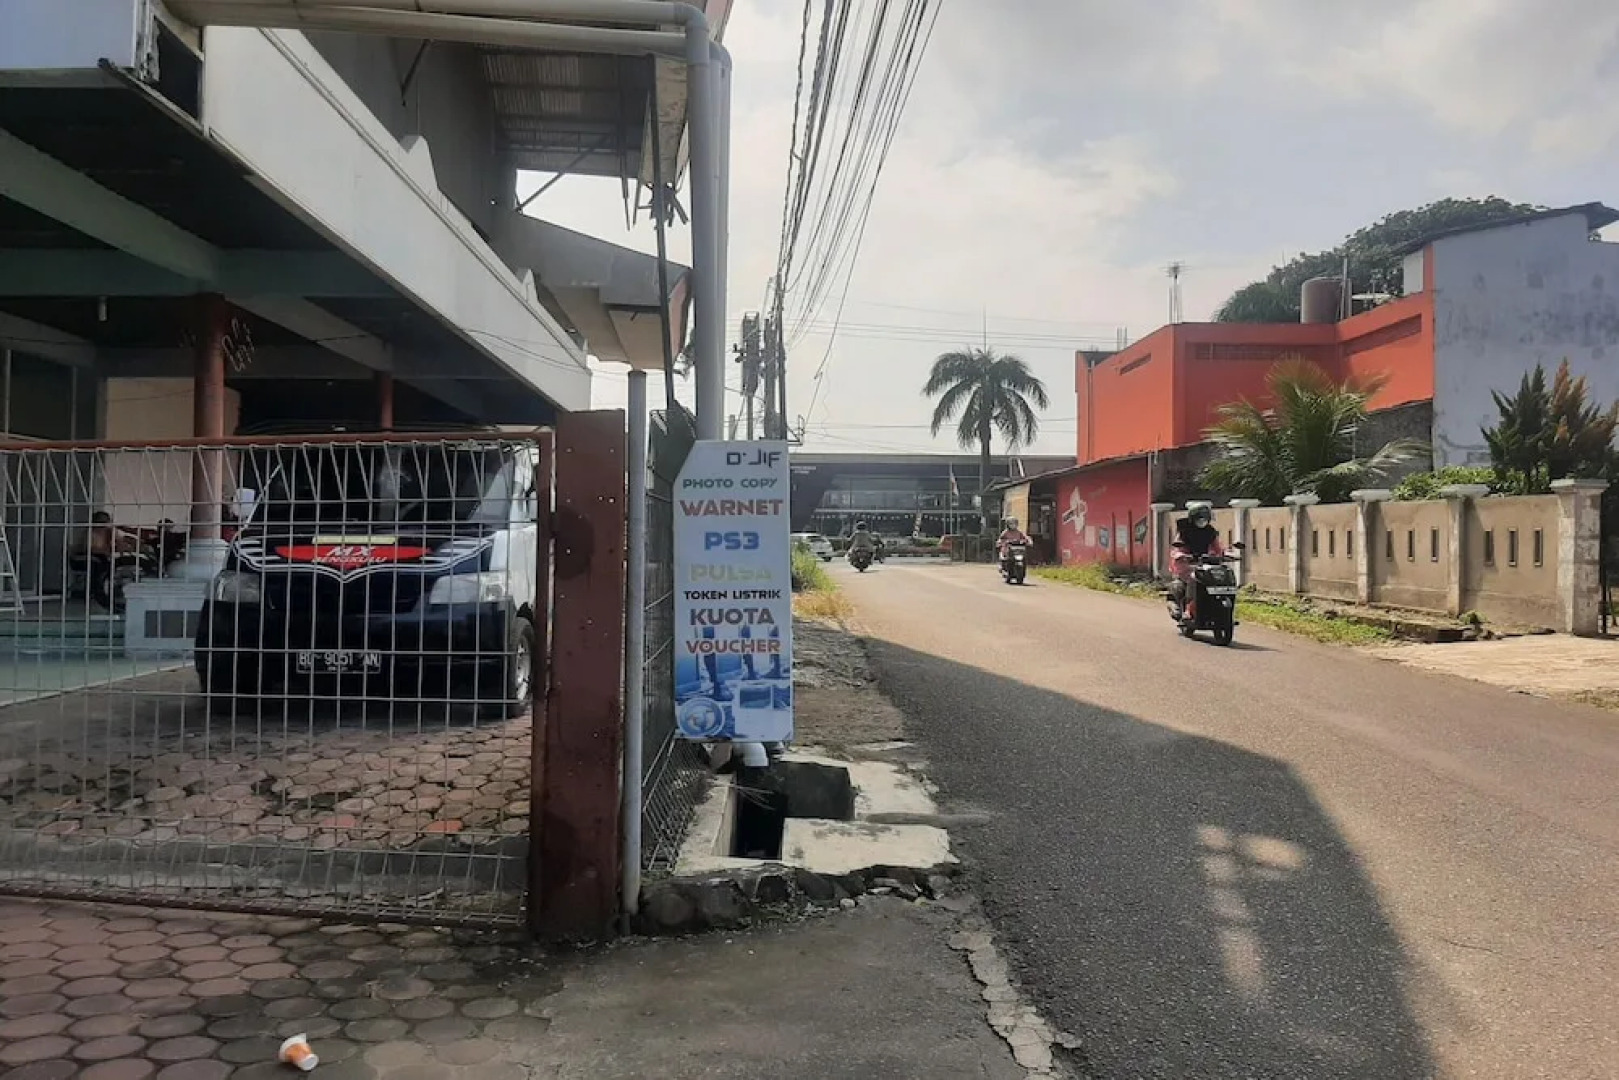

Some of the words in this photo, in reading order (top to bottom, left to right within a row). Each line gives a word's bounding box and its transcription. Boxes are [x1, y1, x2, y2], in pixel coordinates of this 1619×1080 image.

[682, 479, 734, 489] PHOTO
[740, 478, 778, 489] COPY
[679, 499, 783, 516] WARNET
[704, 531, 760, 550] PS3
[683, 590, 728, 600] TOKEN
[732, 589, 781, 599] LISTRIK
[690, 608, 775, 626] KUOTA
[685, 639, 781, 654] VOUCHER
